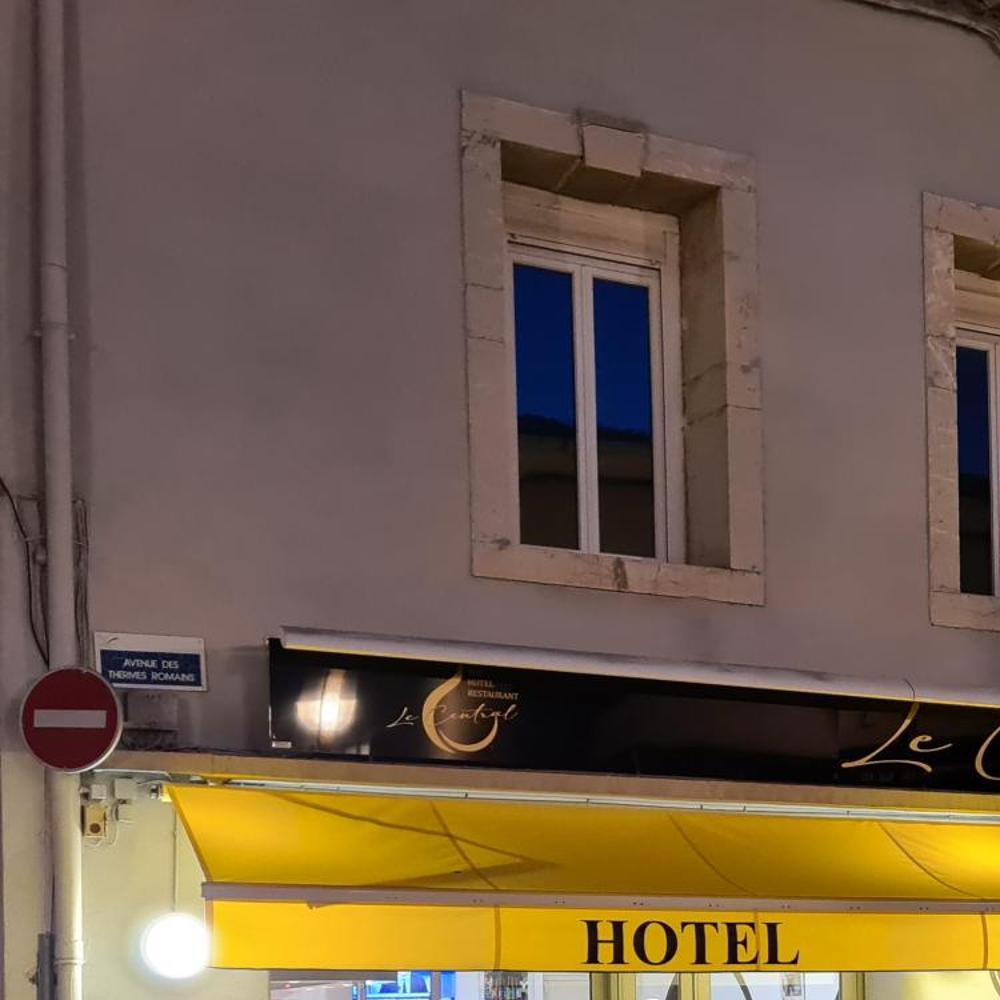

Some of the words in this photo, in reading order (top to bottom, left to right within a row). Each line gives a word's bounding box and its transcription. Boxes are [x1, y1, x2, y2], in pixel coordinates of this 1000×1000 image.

[122, 658, 157, 669] AVENUE
[162, 660, 179, 669] DES
[108, 670, 147, 680] THERMES
[151, 671, 195, 682] ROMAINS
[467, 689, 519, 701] RESTAURANT
[386, 706, 418, 728] Le
[841, 701, 952, 773] Le
[580, 919, 800, 966] HOTEL
